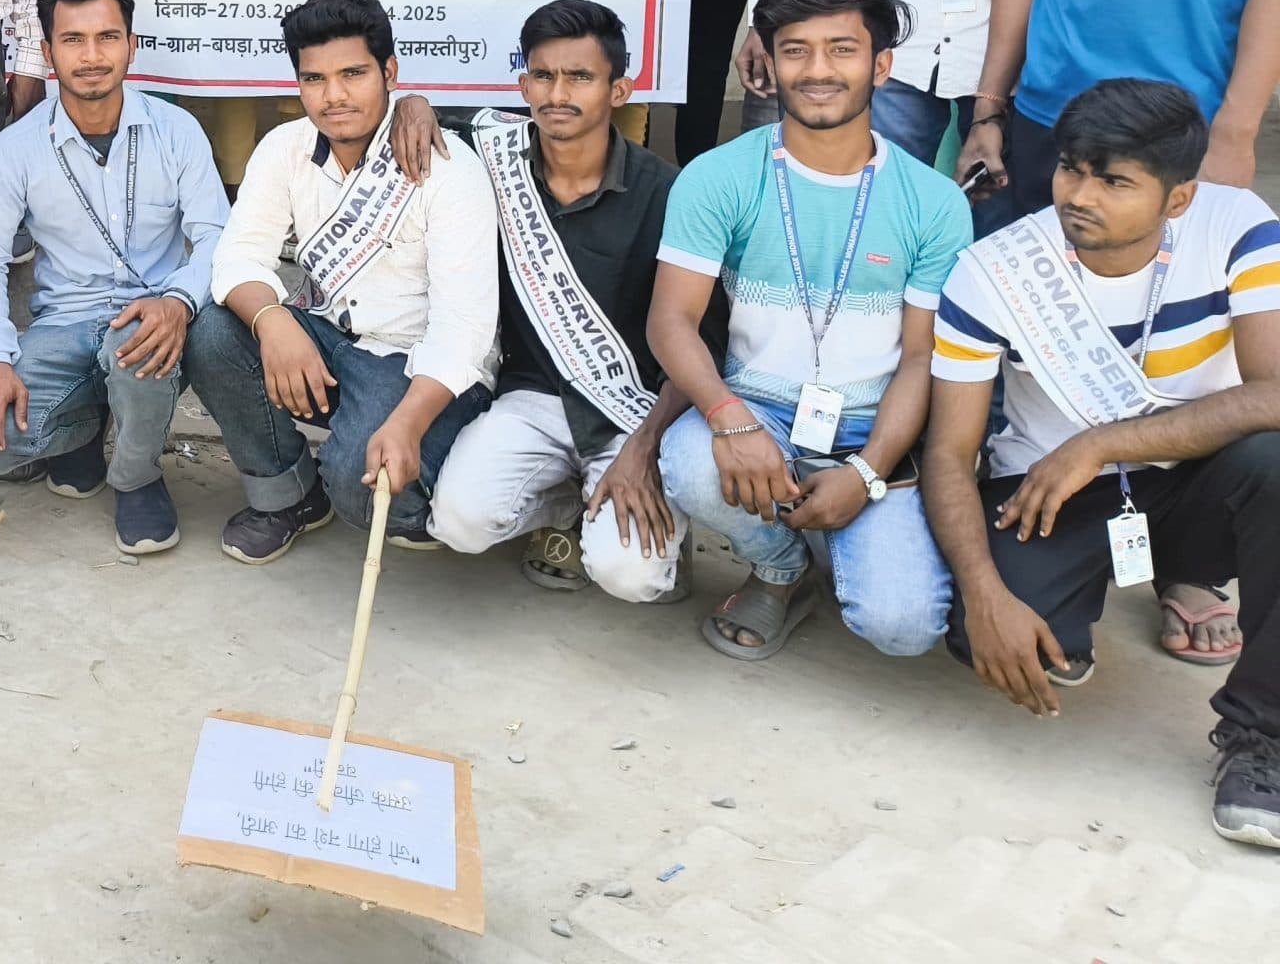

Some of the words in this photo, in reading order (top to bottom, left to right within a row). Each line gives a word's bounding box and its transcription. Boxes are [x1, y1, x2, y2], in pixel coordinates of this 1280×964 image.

[392, 34, 488, 65] (समस्तीपुर)
[352, 172, 400, 244] COLLEGE,
[346, 210, 393, 270] Narayan
[495, 188, 523, 259] Narayan
[519, 260, 551, 320] Mithila
[505, 128, 553, 266] NATIONAL
[552, 271, 625, 380] SERVICE
[511, 206, 549, 288] COLLEGE,
[548, 289, 603, 382] MOHANPUR
[1003, 223, 1086, 343] ATIONAL
[992, 262, 1040, 339] Narayan
[1021, 279, 1079, 371] COLLEGE,
[253, 770, 287, 790] होगी
[292, 779, 315, 799] की
[332, 784, 365, 807] जीव
[371, 790, 413, 812] उसके
[285, 821, 306, 841] का
[314, 827, 341, 850] नशे
[347, 832, 382, 860] होगा
[389, 839, 421, 865] "जो
